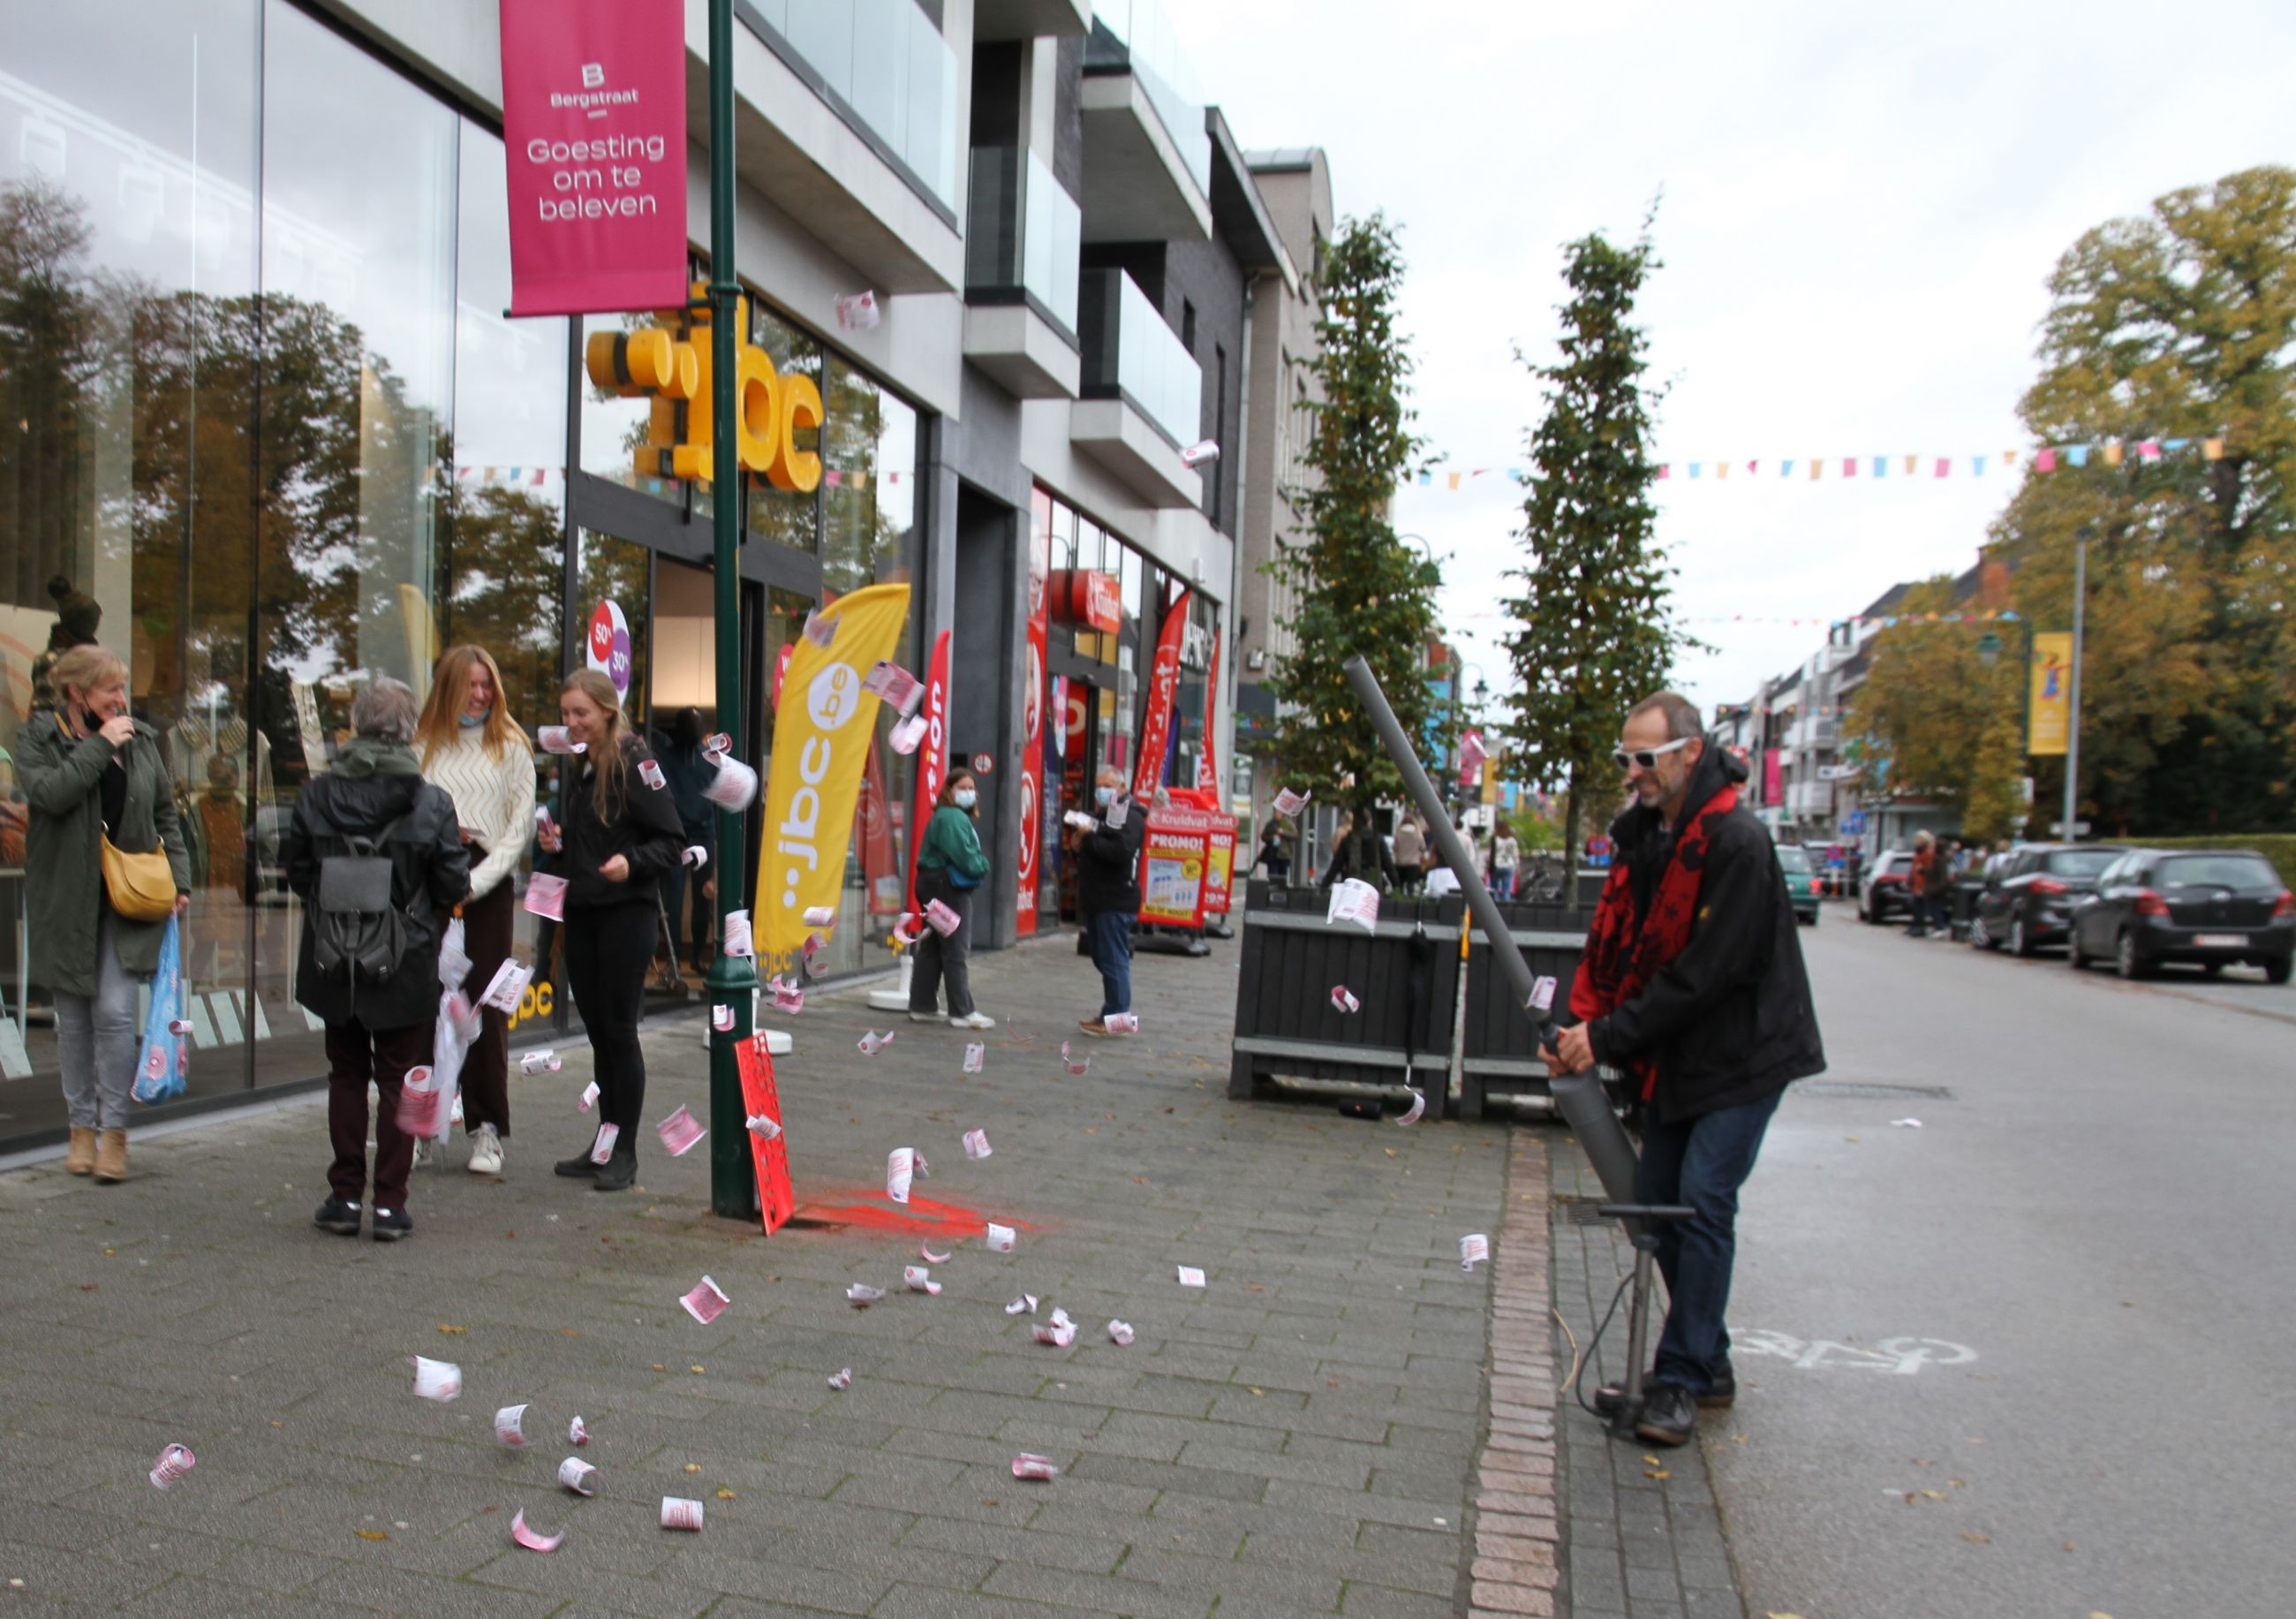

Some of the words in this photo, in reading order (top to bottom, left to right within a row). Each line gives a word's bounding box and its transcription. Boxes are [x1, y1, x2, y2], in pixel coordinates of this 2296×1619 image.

[581, 63, 605, 87] B
[549, 88, 639, 109] Bergstraat
[526, 133, 665, 164] Goesting
[553, 166, 602, 192] om
[612, 164, 642, 188] te
[539, 193, 657, 222] beleven
[1160, 813, 1209, 829] Kruidvat
[1150, 833, 1205, 851] PROMO!
